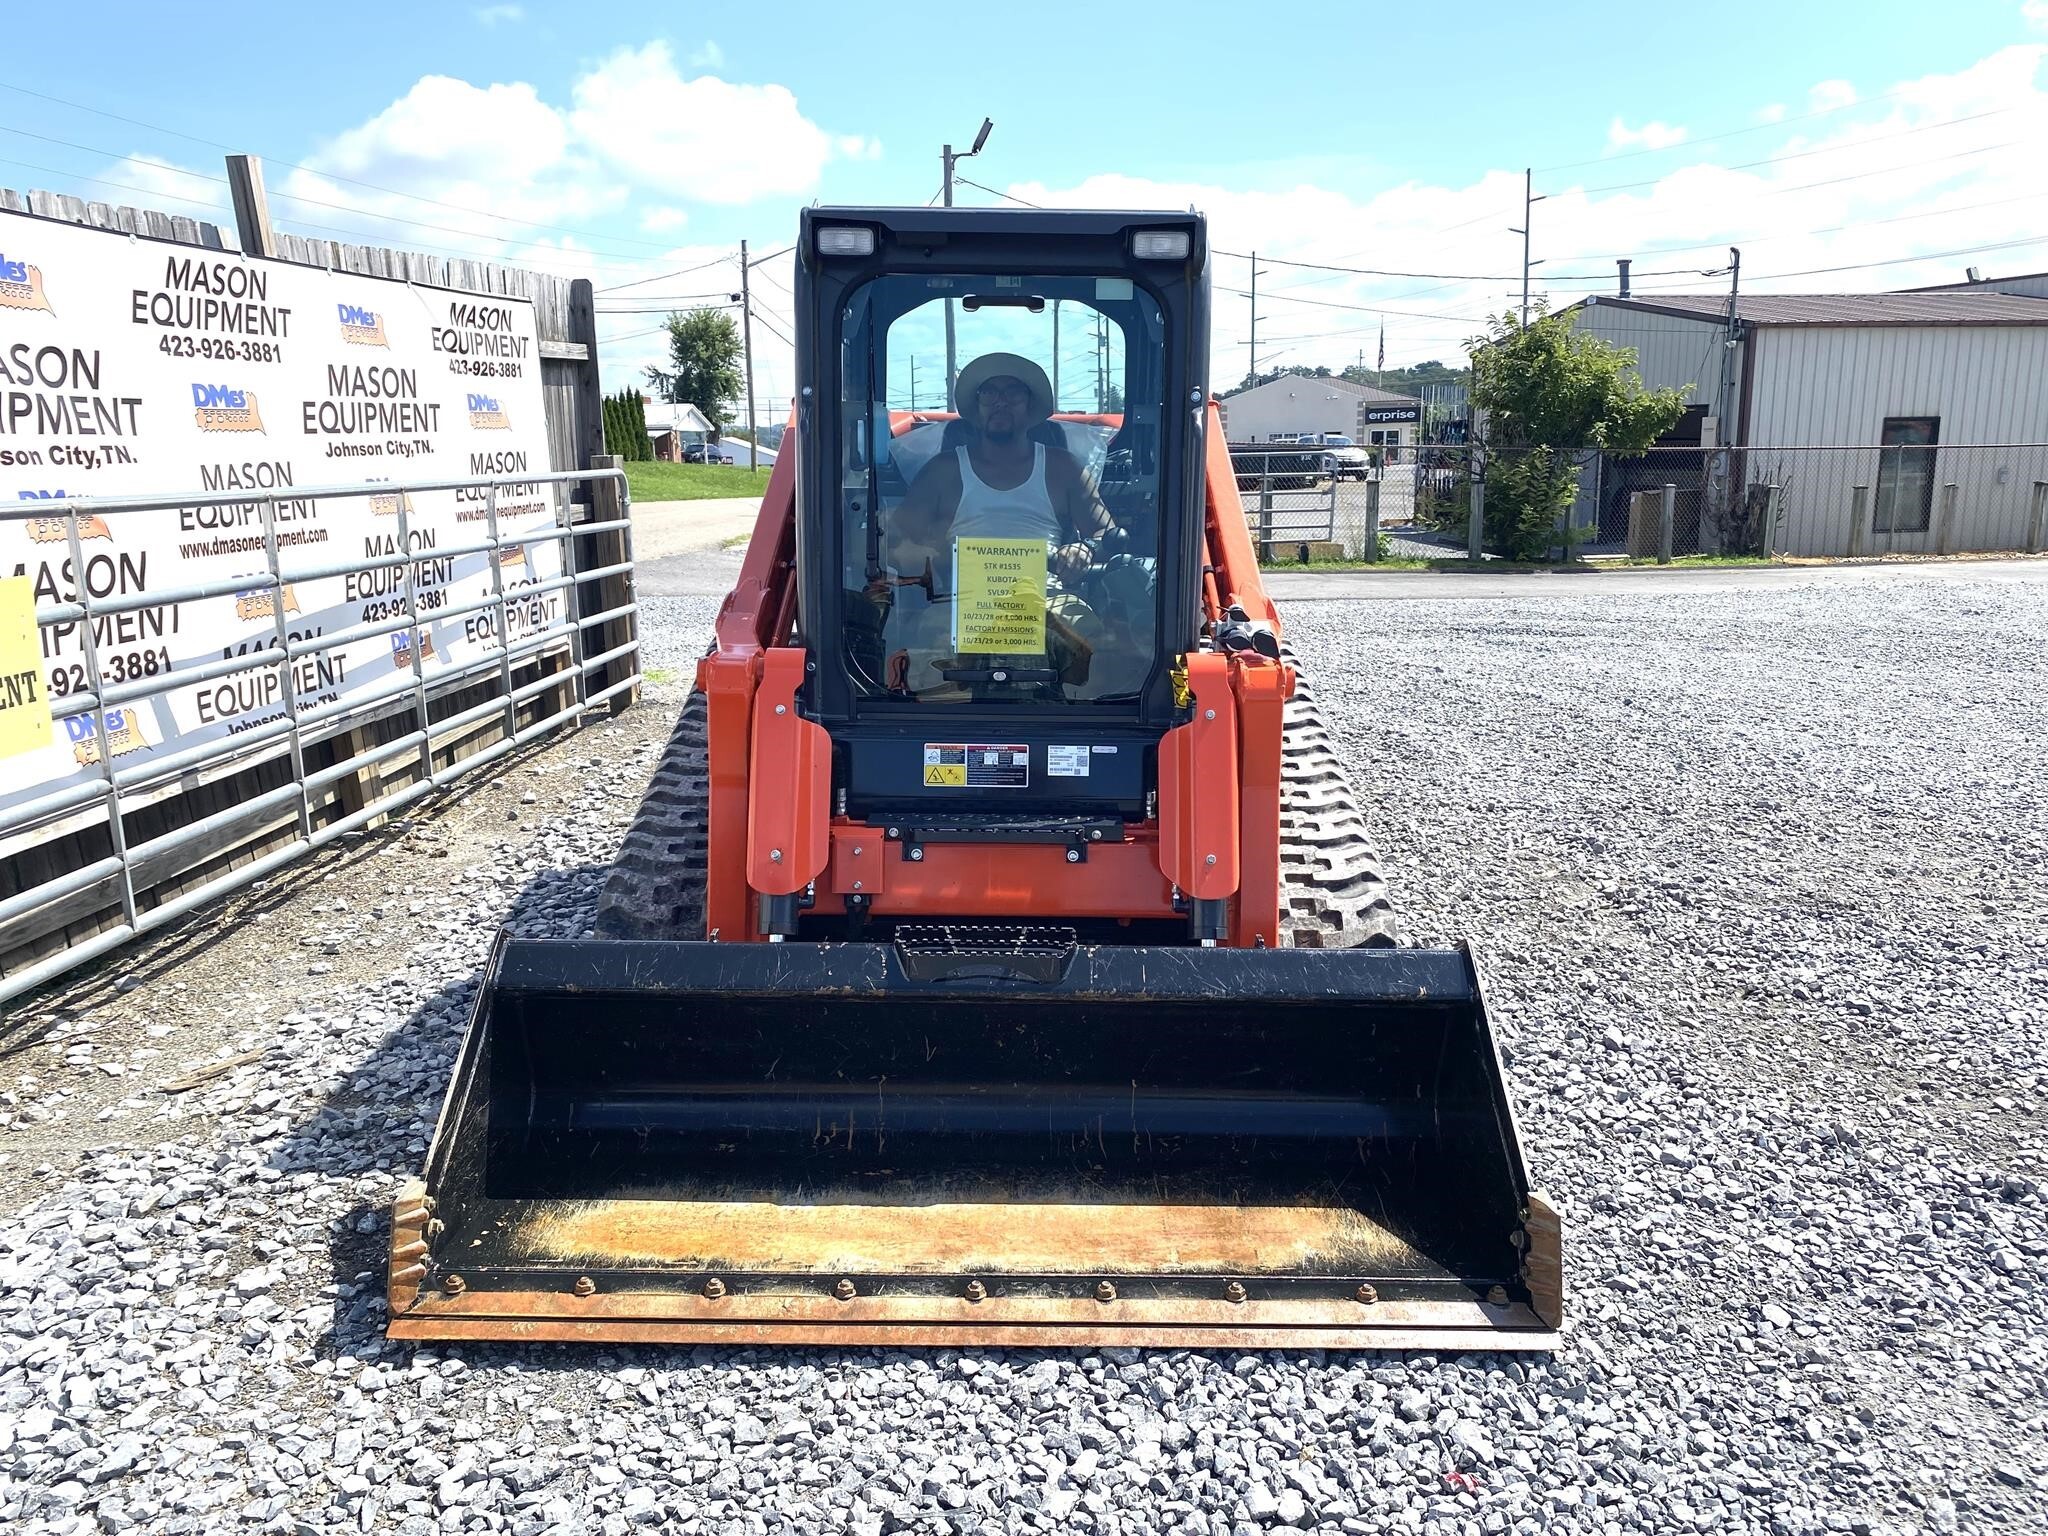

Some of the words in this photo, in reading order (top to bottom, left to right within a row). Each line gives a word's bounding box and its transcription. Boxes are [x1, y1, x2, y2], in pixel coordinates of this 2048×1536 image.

[165, 256, 267, 301] MASON
[132, 289, 292, 338] EQUIPMENT
[450, 302, 513, 332] MASON
[159, 334, 282, 363] 423-926-3881
[431, 327, 529, 359] EQUIPMENT
[327, 364, 417, 399] MASON
[449, 358, 523, 378] 423-926-3881
[302, 401, 441, 435] EQUIPMENT
[1368, 409, 1416, 422] erprise
[0, 449, 44, 466] son
[325, 442, 383, 458] Johnson
[470, 451, 528, 475] MASON
[200, 460, 294, 492] MASON
[455, 482, 541, 503] EQUPMEN
[455, 502, 546, 524] www.dmanequipment.com
[178, 527, 329, 561] www.dmasoneqpment.com
[365, 528, 436, 558] MAON
[362, 588, 448, 624] 423-92-3881
[465, 597, 558, 643] EQUPMENT
[976, 601, 993, 609] FULL
[965, 625, 996, 633] FACTORY
[1003, 637, 1022, 646] 3,000
[47, 646, 173, 698] -92-3881
